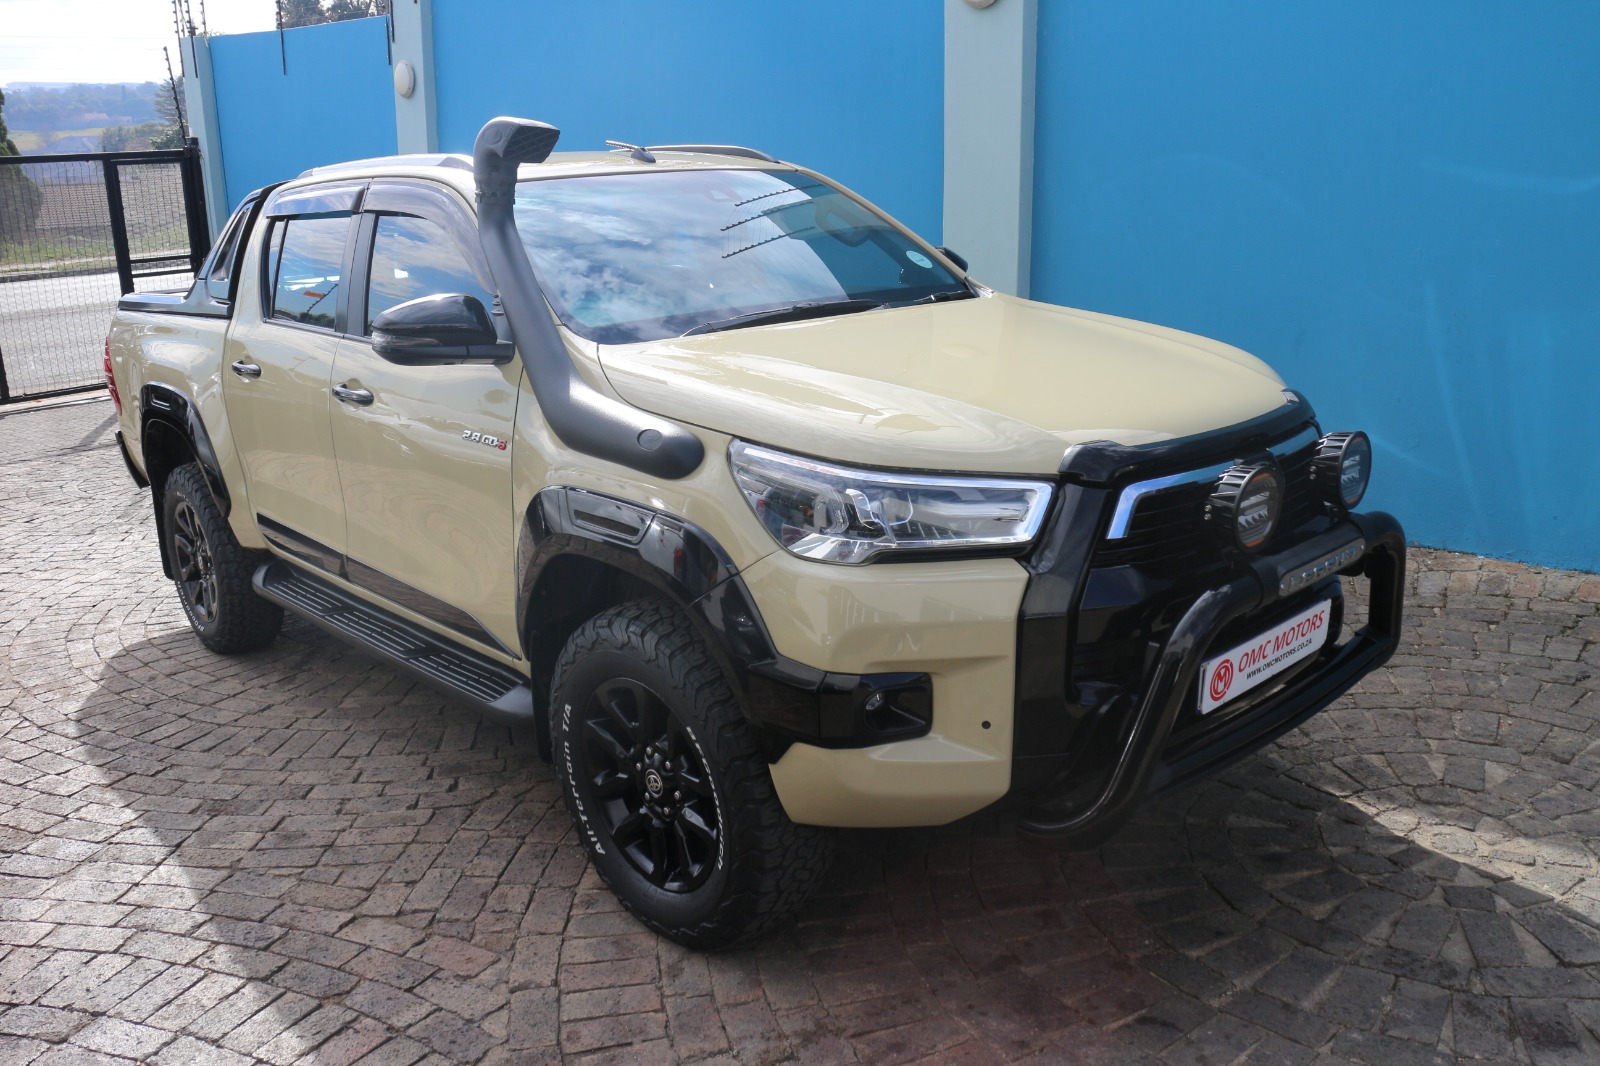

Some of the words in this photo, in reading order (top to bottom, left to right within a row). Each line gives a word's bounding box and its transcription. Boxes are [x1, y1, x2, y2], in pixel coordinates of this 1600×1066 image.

[1238, 640, 1271, 673] OMC
[1272, 610, 1325, 655] MOTORS
[1246, 638, 1312, 680] WWW.OMCMOTORS.CO.ZA
[562, 703, 572, 732] T/A
[563, 741, 606, 855] All-Terrain
